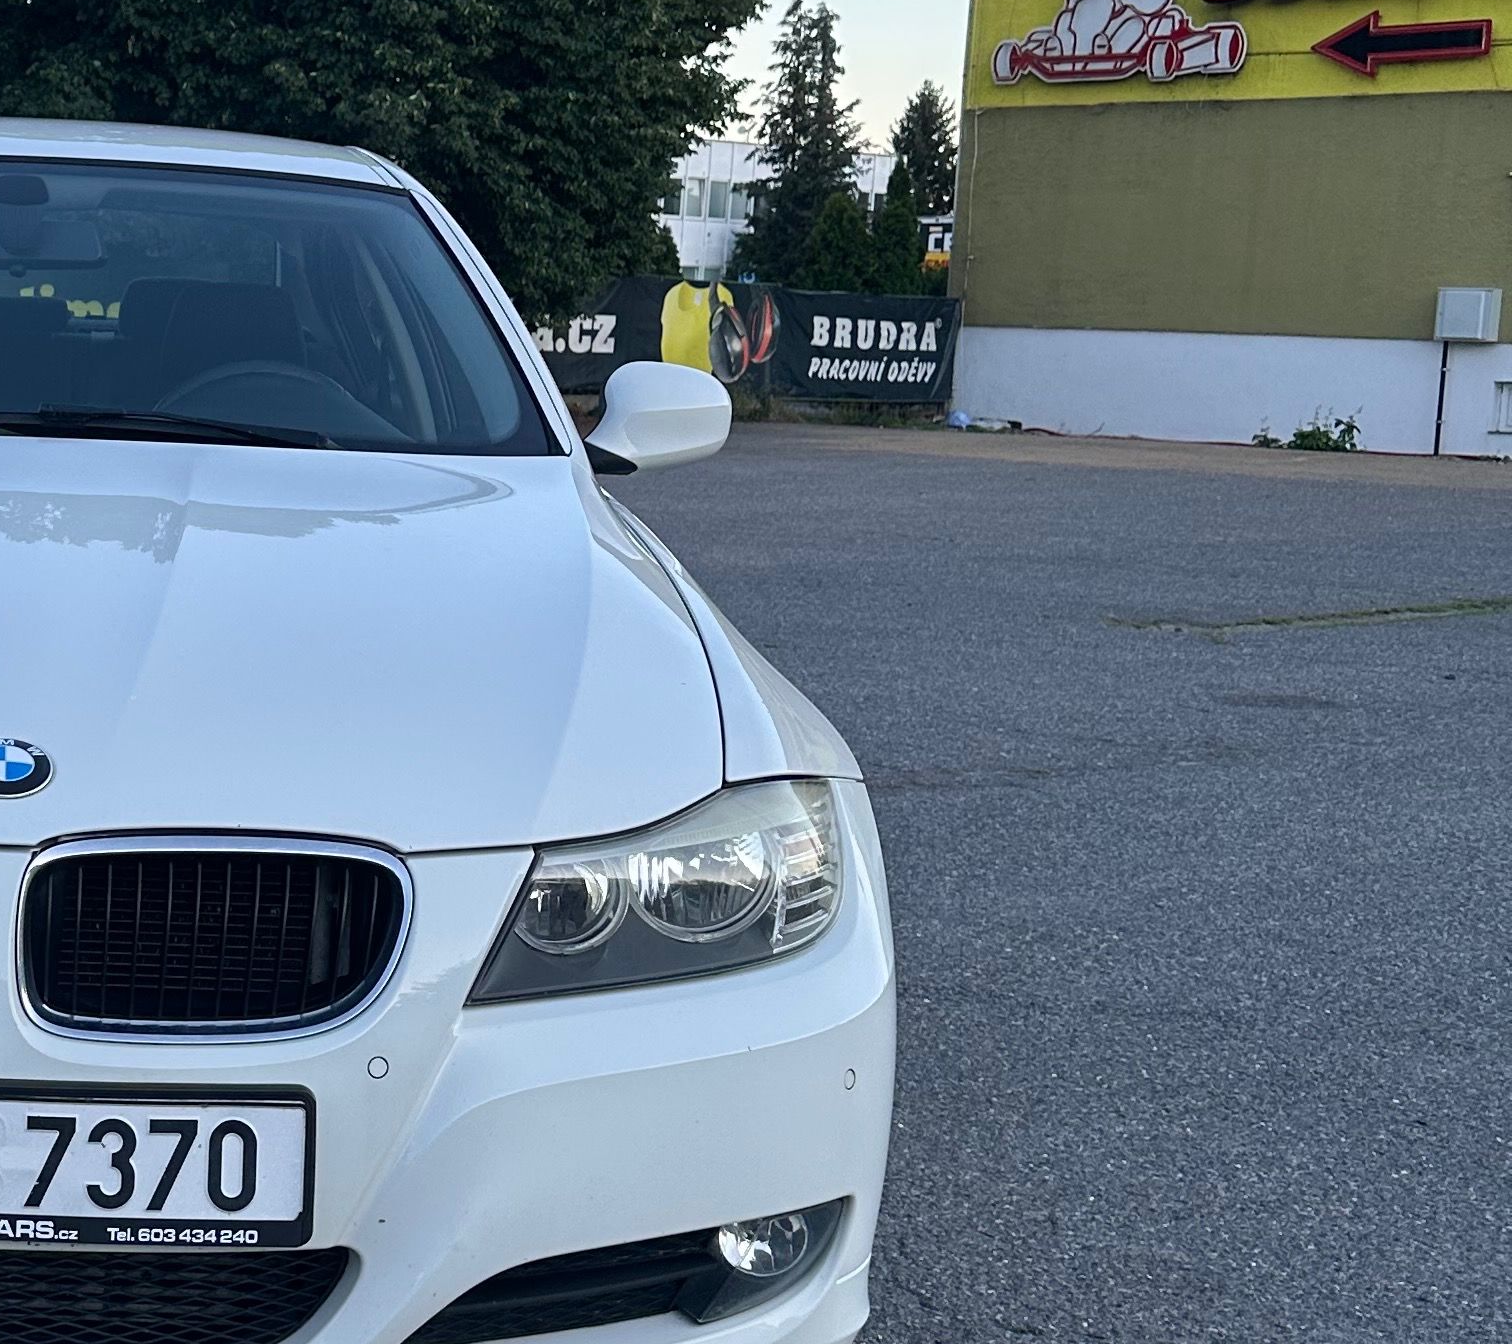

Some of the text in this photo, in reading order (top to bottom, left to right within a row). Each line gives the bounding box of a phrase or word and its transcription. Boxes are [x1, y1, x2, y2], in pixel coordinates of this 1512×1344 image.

[808, 356, 937, 384] PRACOVNÍ ODĚVY
[23, 1115, 258, 1212] 7370
[106, 1226, 135, 1242] Tel.
[137, 1228, 176, 1243] 603
[178, 1228, 217, 1244] 434
[219, 1229, 258, 1244] 240
